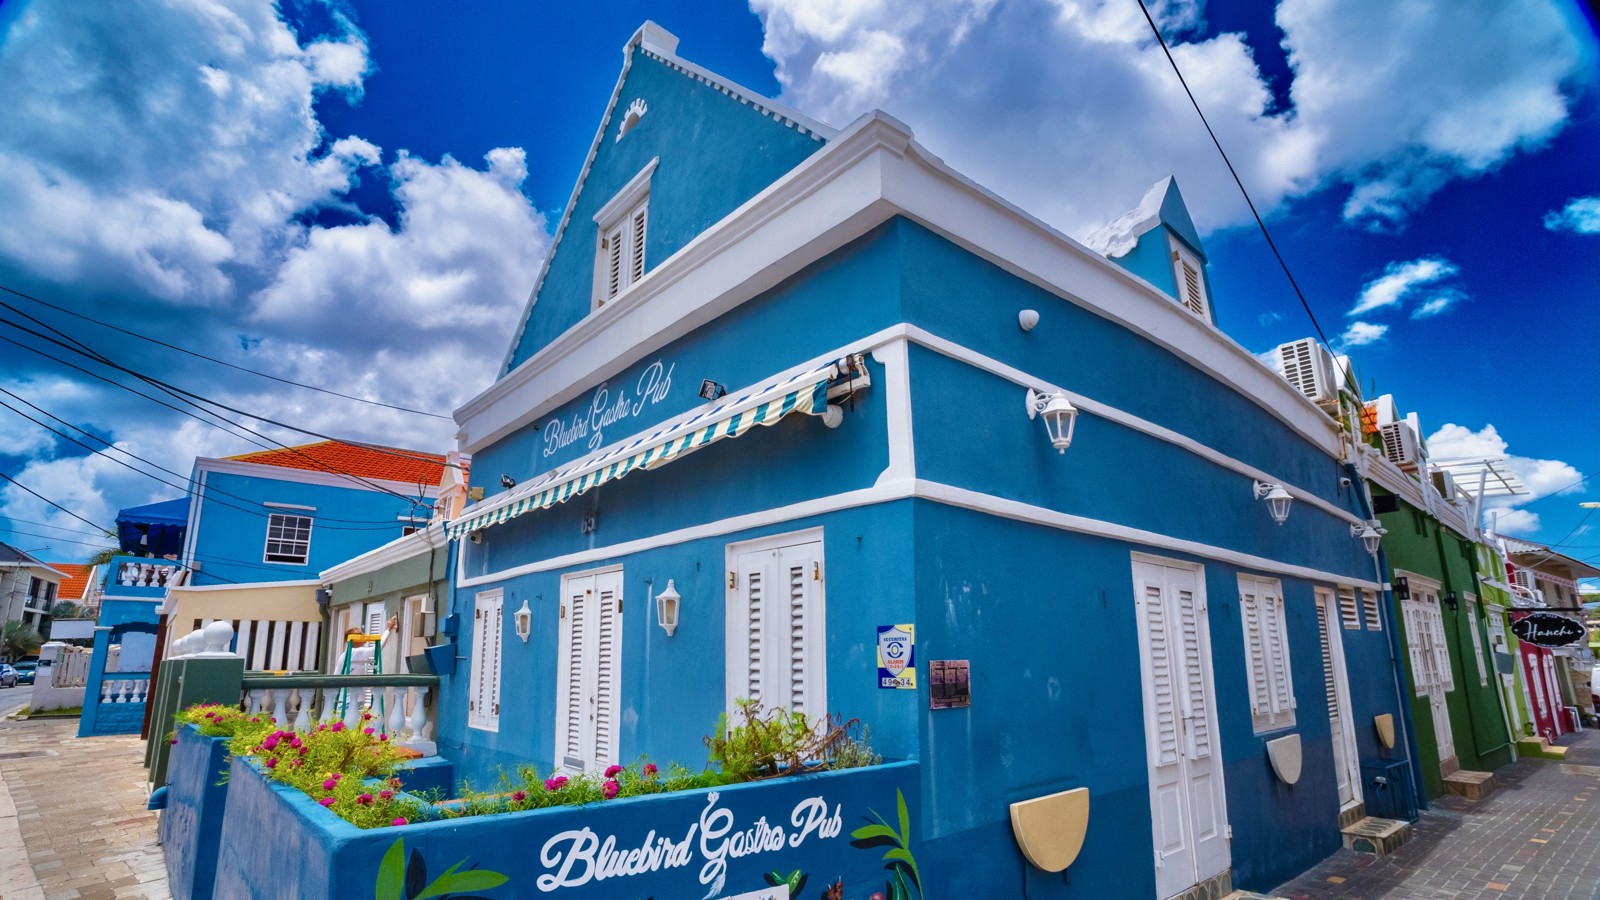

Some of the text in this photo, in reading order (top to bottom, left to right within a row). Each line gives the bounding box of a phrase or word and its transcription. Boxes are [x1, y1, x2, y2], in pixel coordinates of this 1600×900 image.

[543, 359, 676, 458] Bluebird Gastro Pub
[536, 795, 843, 892] Bluebird Gastro Pub
